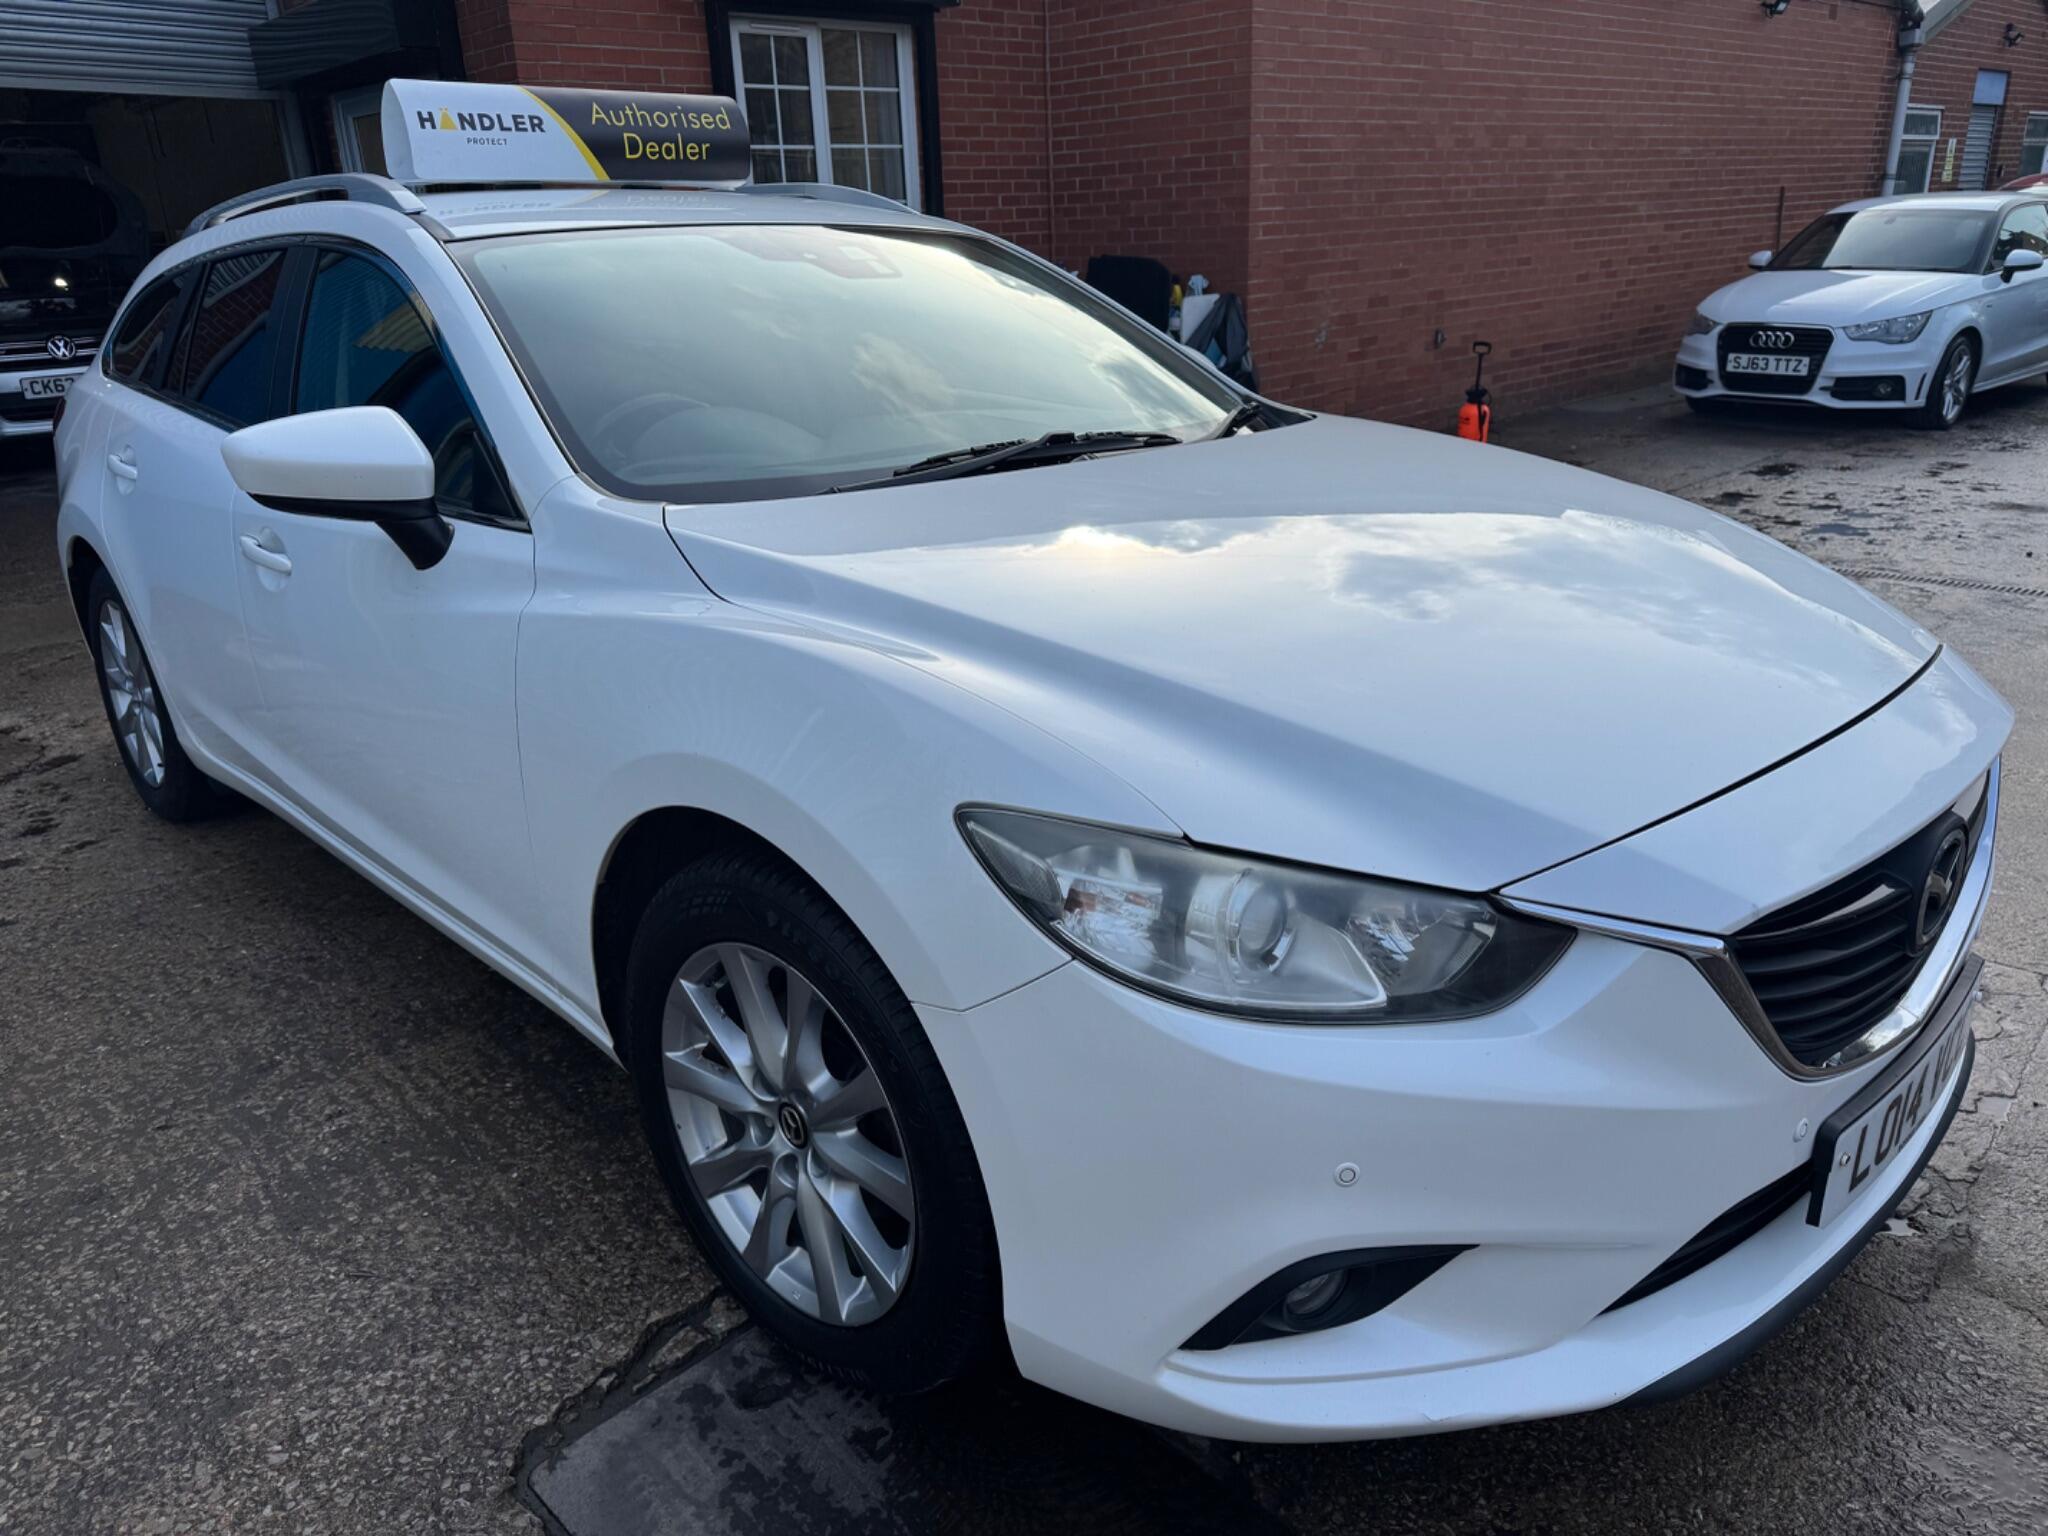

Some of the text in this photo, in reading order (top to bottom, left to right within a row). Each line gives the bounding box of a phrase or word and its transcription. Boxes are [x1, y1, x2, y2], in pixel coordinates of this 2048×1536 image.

[590, 102, 732, 130] Authorised
[466, 137, 508, 146] PROTECT
[623, 132, 711, 161] Dealer
[1732, 356, 1804, 372] SJ63 TTZ
